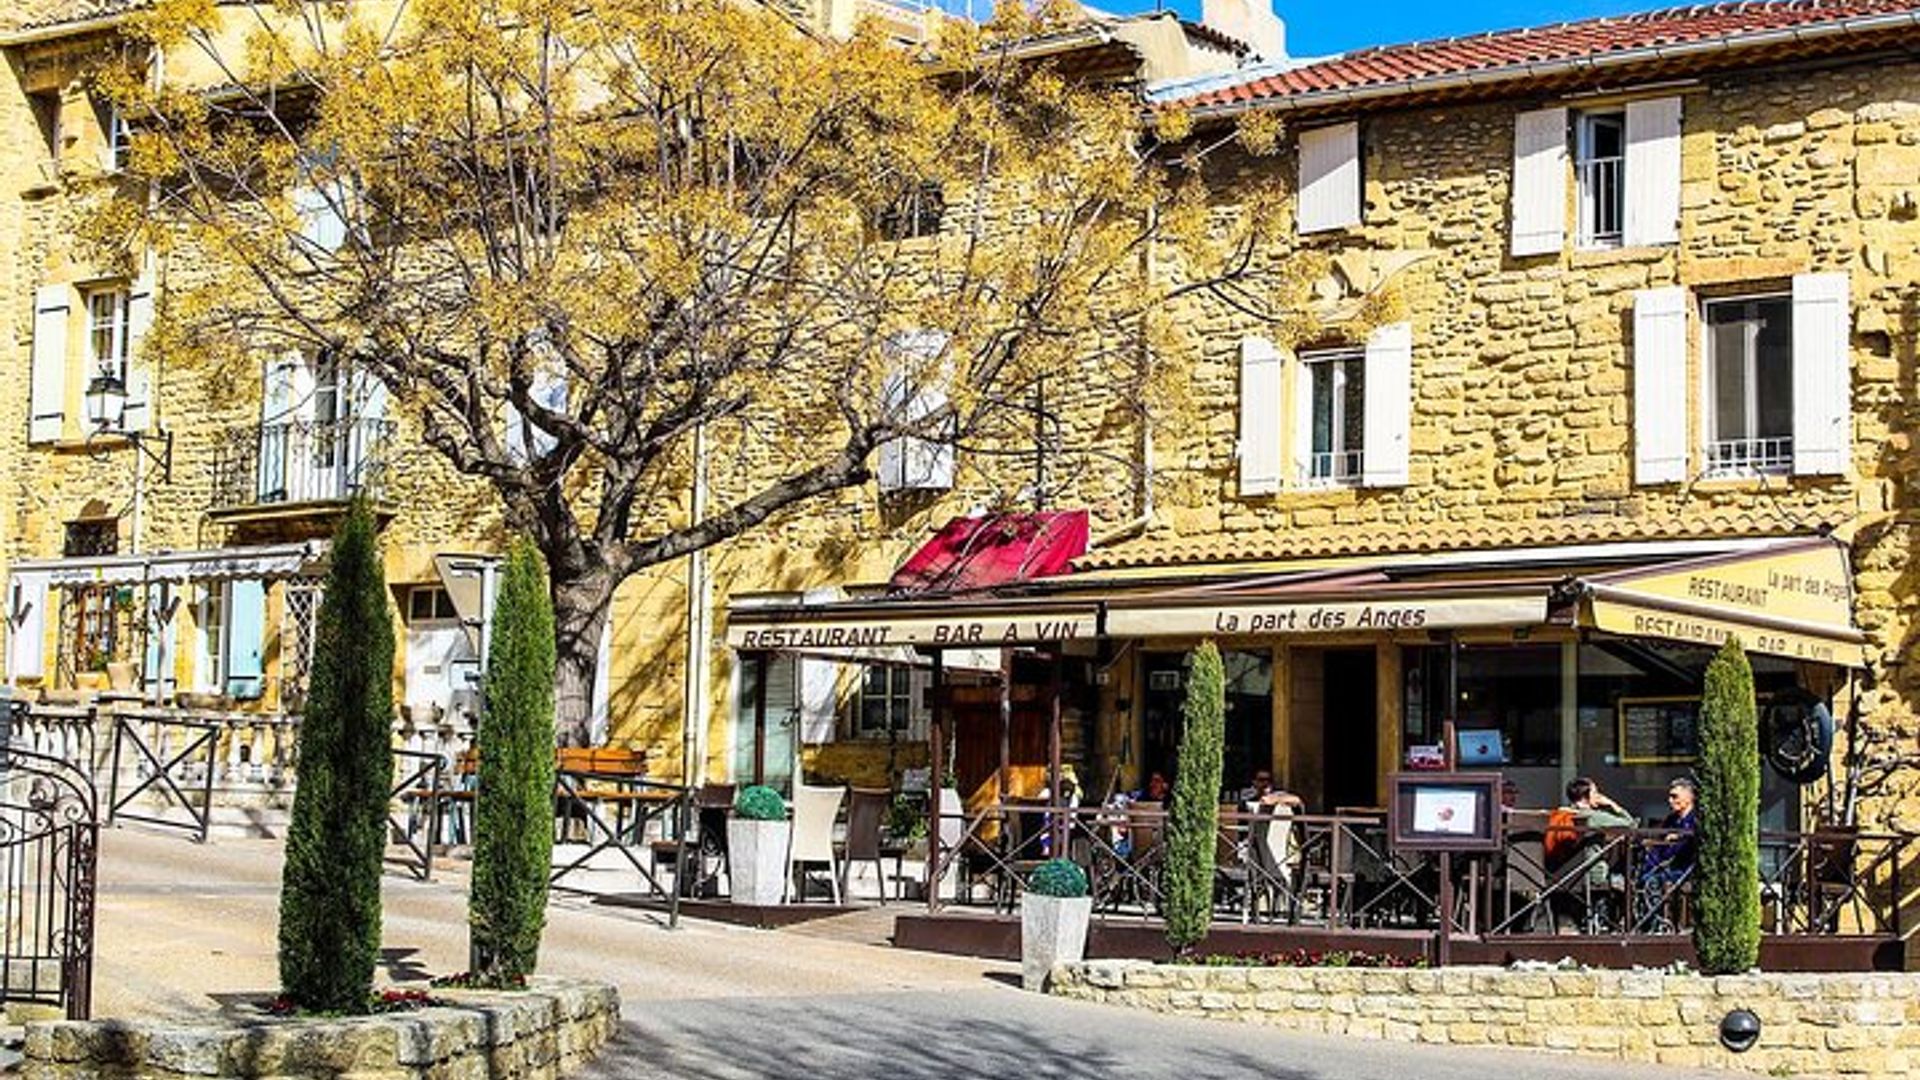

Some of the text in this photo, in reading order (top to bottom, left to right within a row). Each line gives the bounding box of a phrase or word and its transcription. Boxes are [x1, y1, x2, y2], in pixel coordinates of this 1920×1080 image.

[1689, 577, 1767, 606] RESTAURANT
[1215, 606, 1425, 633] La part des Anges
[742, 626, 891, 648] RESTAURANT
[933, 623, 983, 643] BAR
[1002, 622, 1019, 642] A
[1036, 621, 1079, 640] VIN
